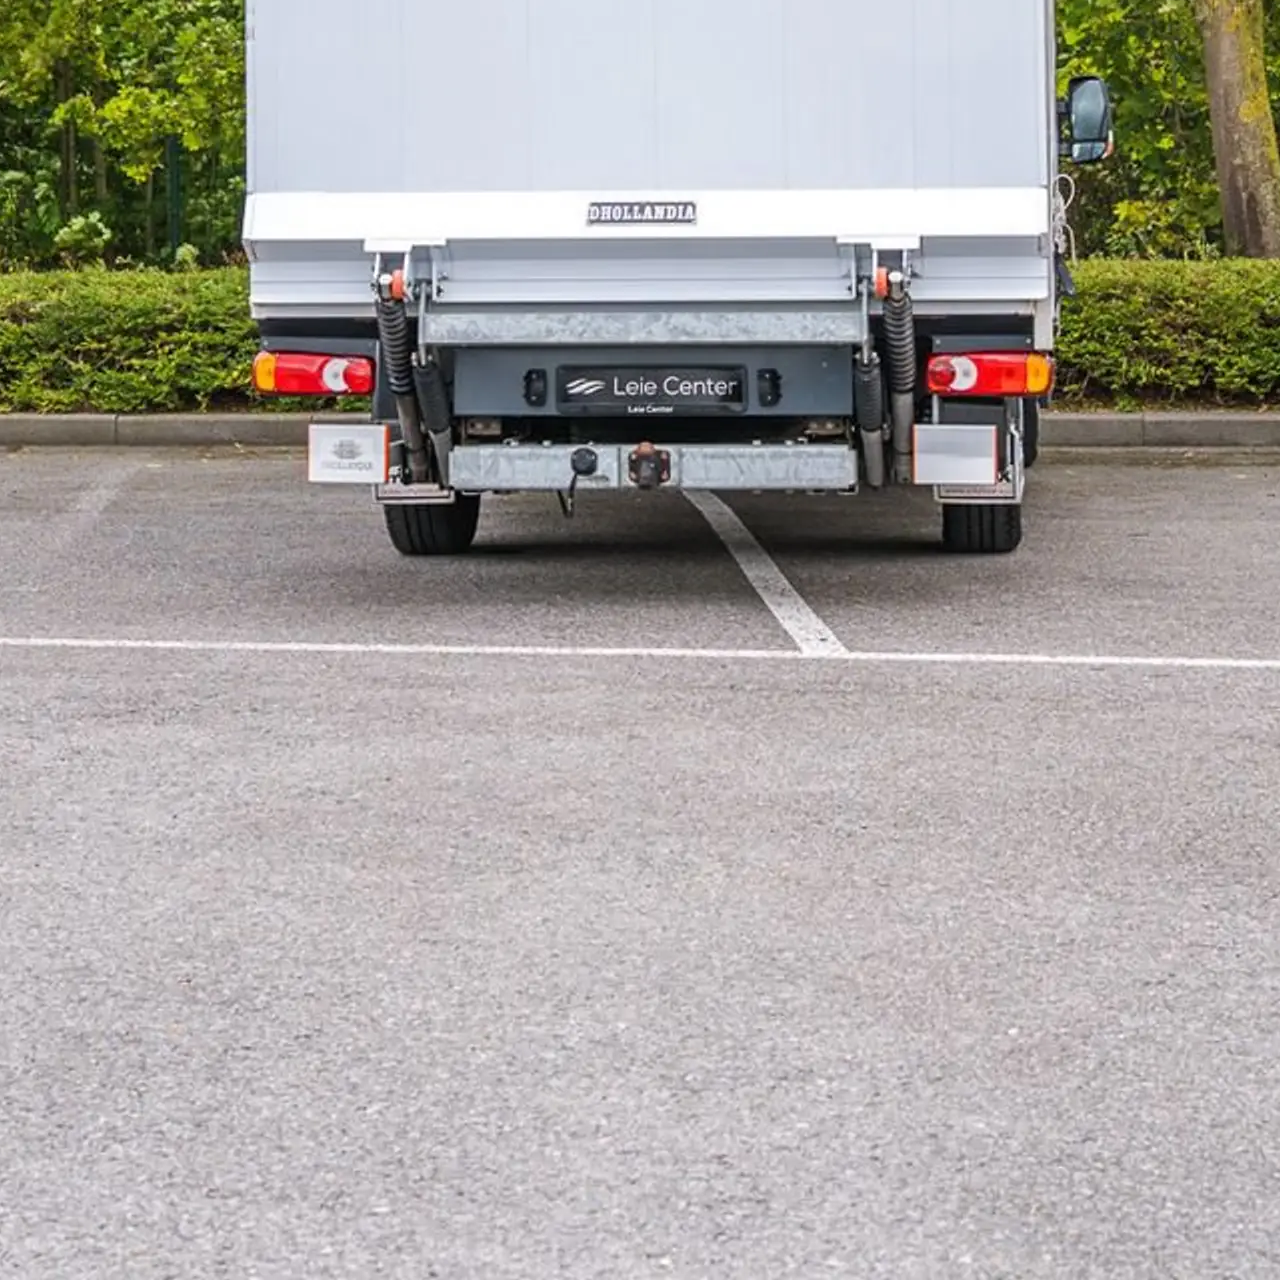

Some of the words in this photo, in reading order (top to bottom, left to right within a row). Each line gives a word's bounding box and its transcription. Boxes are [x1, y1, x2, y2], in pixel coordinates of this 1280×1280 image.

[589, 204, 695, 221] DHOLLANDIA
[613, 376, 657, 396] Leie
[663, 376, 737, 396] Center
